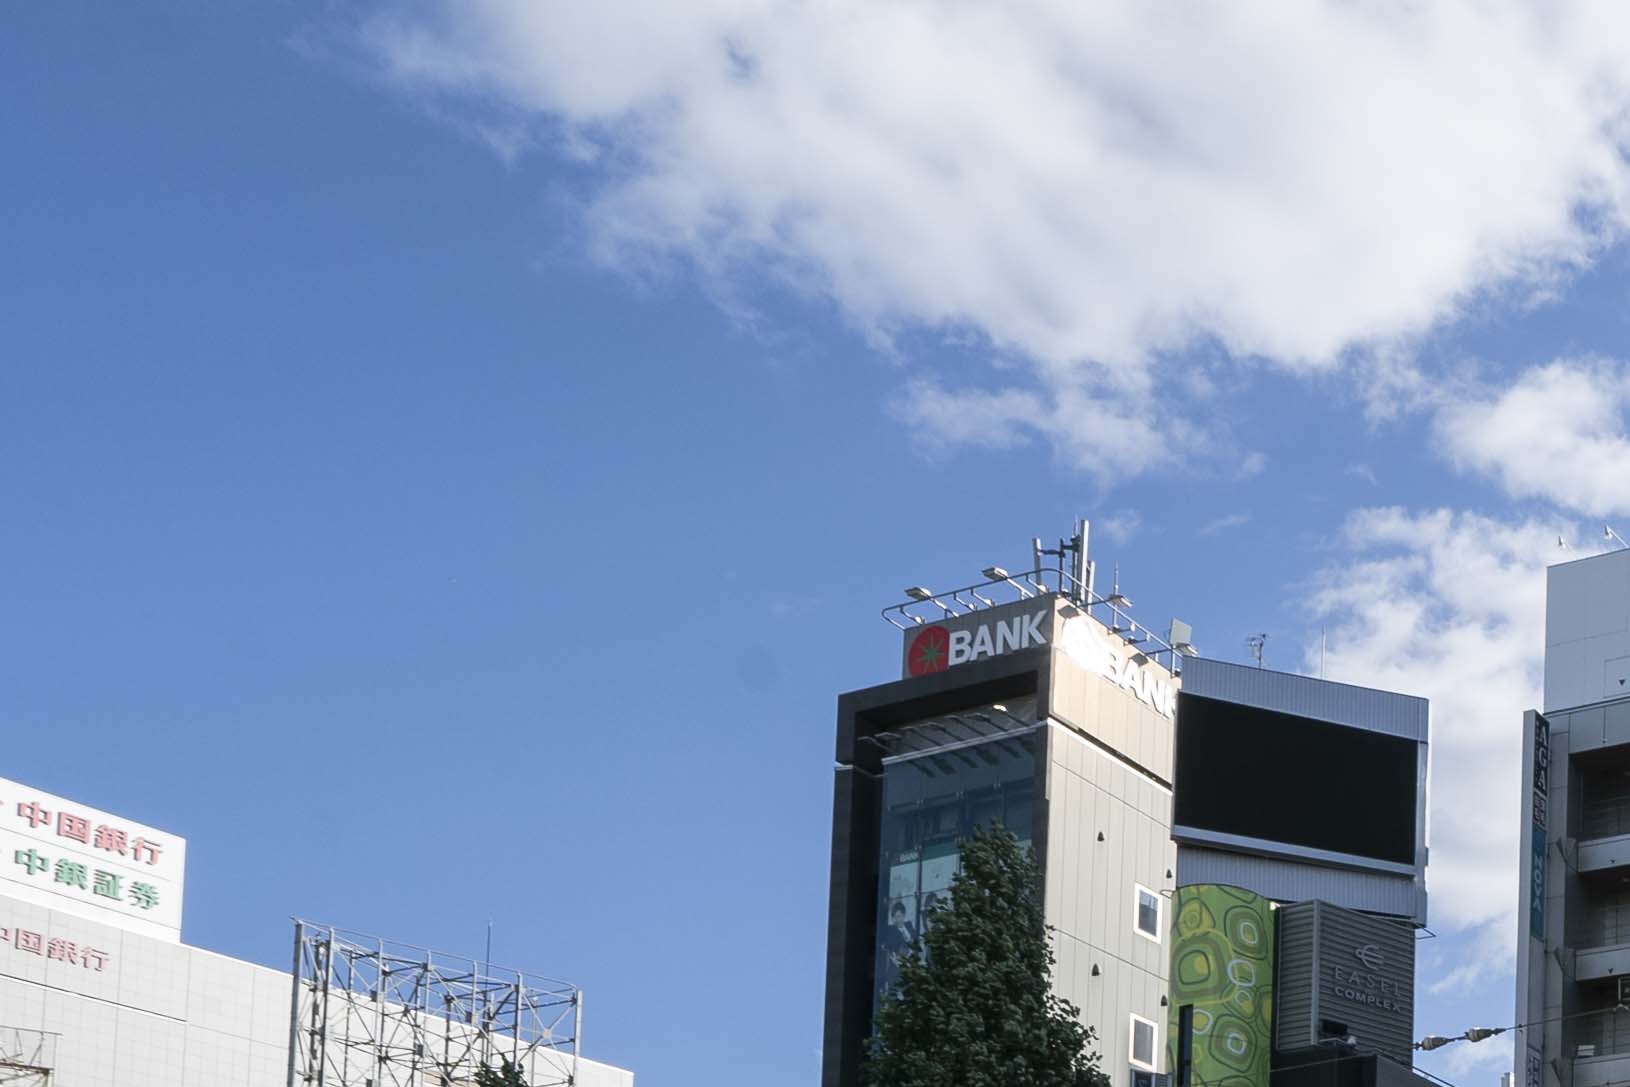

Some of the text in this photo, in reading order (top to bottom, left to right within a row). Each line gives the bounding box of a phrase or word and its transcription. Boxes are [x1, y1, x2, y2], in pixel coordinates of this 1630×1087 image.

[949, 609, 1050, 667] BANK
[17, 801, 164, 866] 中国銀行
[15, 848, 160, 910] 中銀証券
